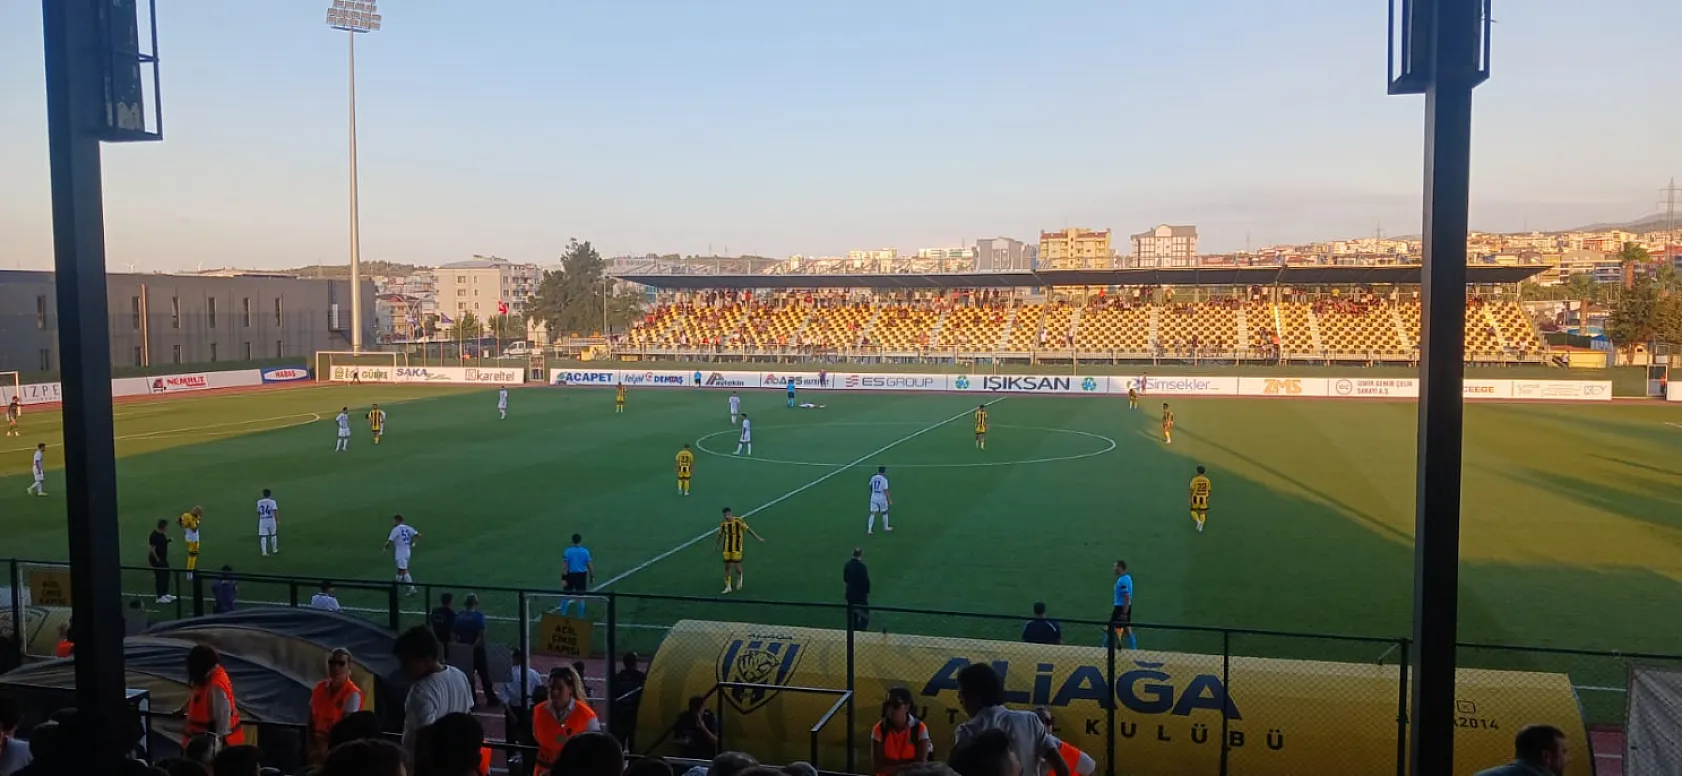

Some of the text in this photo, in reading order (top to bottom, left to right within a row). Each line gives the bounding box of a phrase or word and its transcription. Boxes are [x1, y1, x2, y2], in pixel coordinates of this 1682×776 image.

[396, 368, 428, 377] SAKA
[565, 372, 613, 382] ACAPET
[167, 376, 204, 386] NEMRUT
[983, 376, 1070, 391] IŞIKSAN
[1264, 379, 1302, 394] ZMS
[258, 504, 271, 515] 34
[1085, 718, 1284, 751] KULÜBÜ
